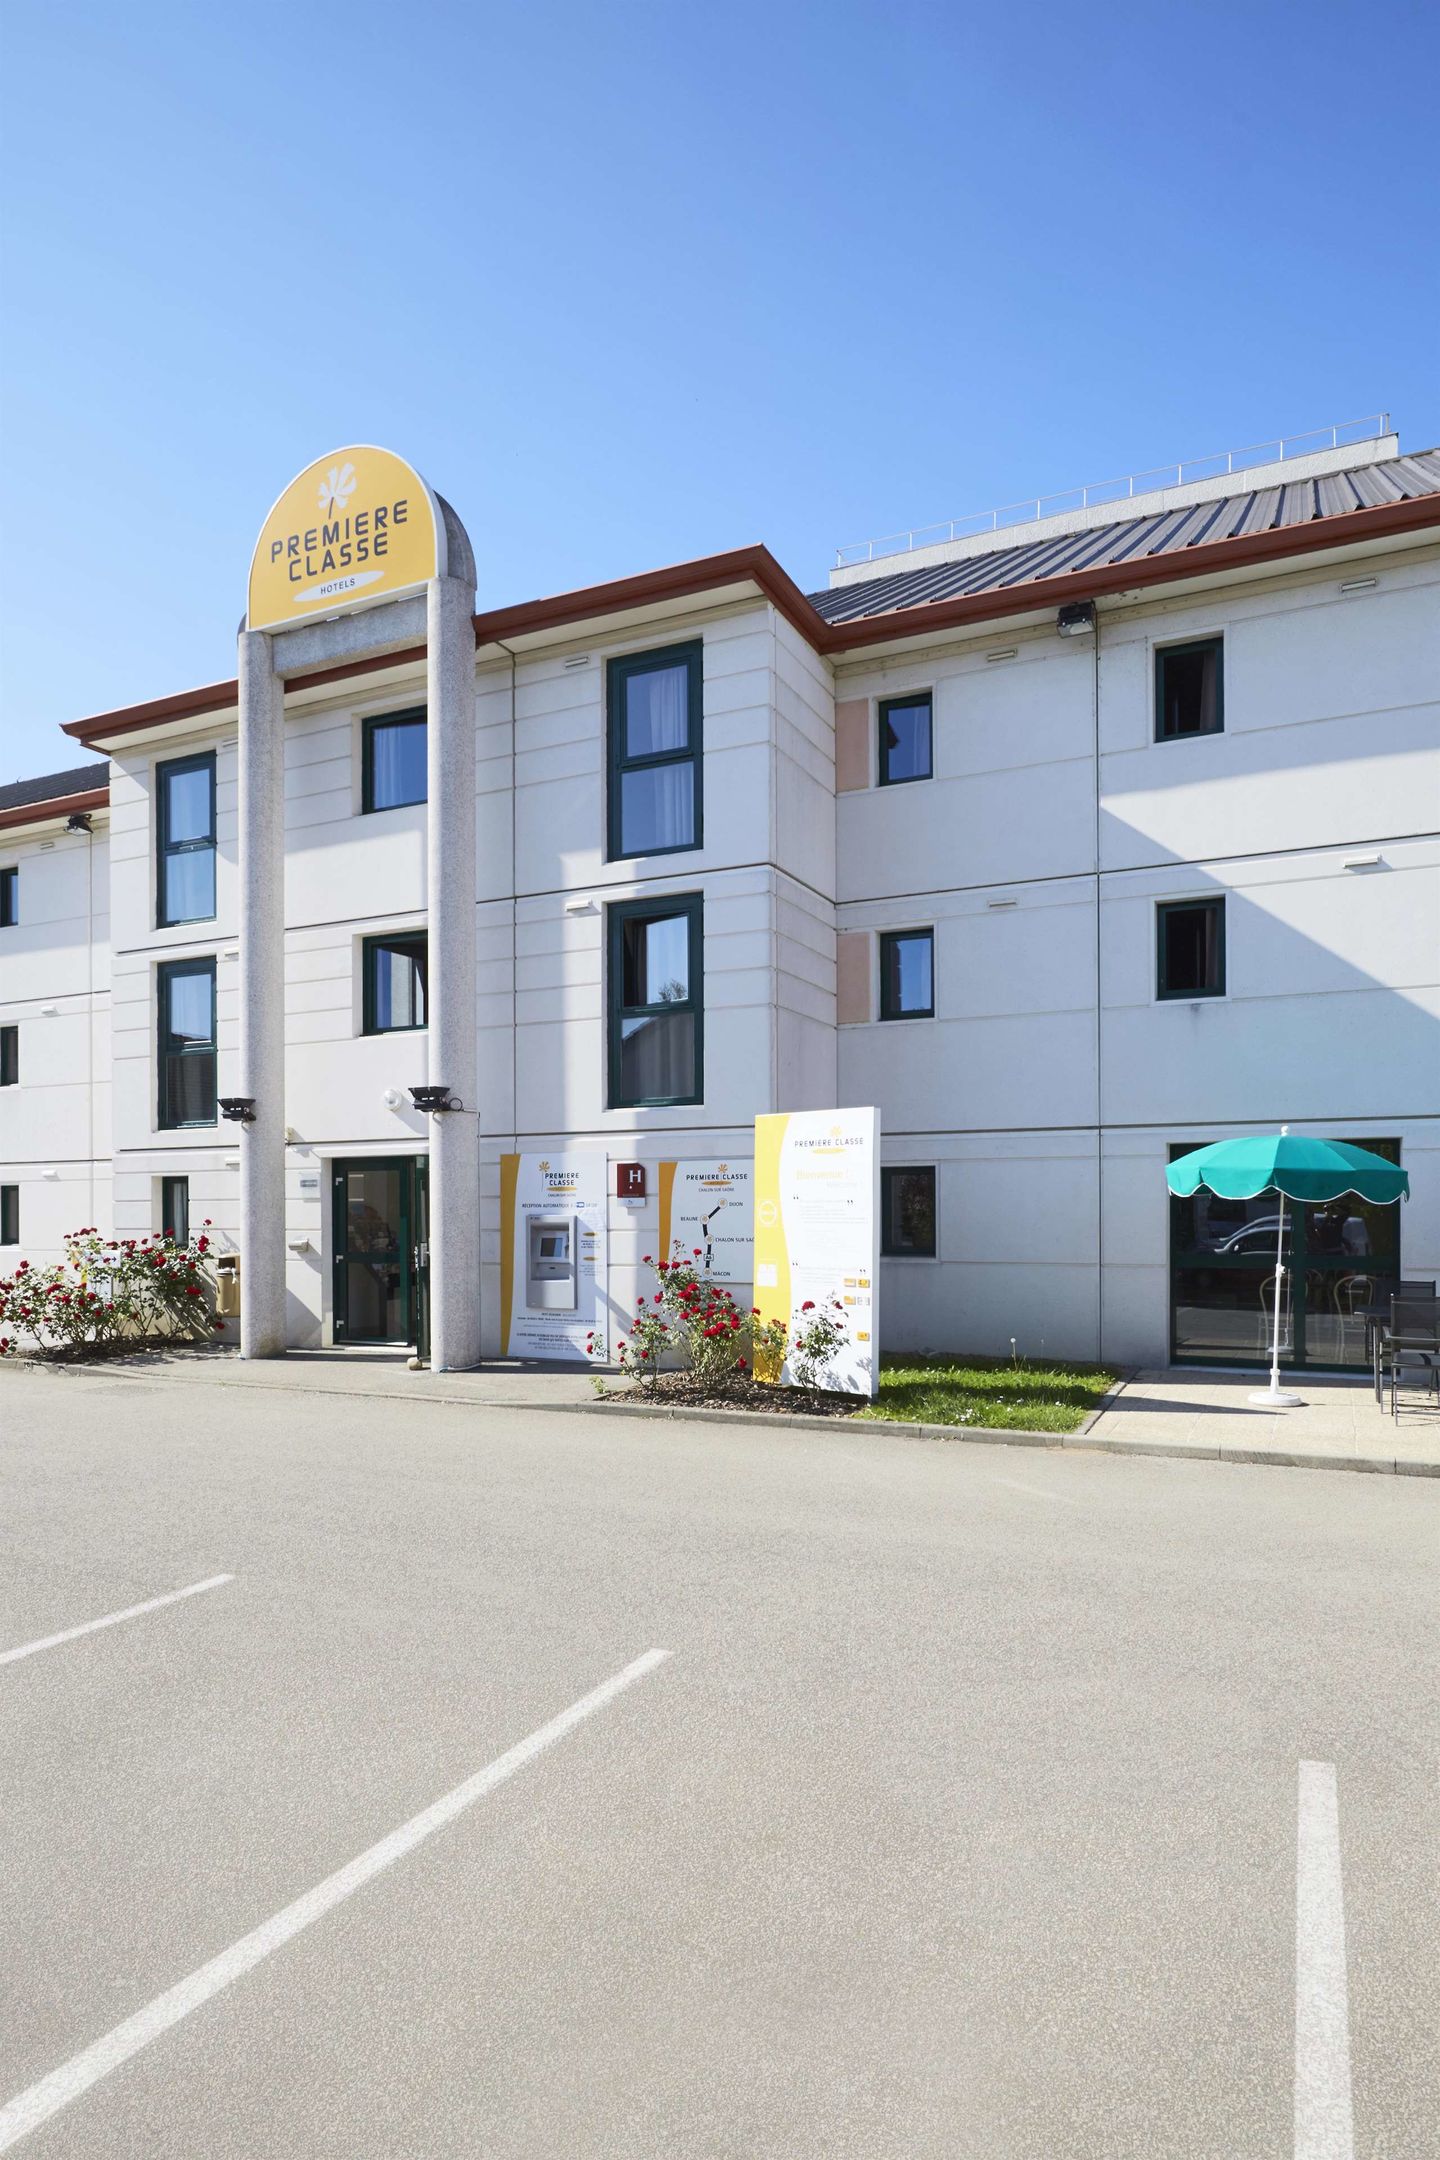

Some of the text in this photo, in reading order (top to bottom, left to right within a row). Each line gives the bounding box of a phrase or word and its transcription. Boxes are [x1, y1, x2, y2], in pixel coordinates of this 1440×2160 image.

[271, 500, 408, 563] PREMIERE
[289, 532, 388, 582] CLASSE
[320, 578, 356, 595] HOTELS
[630, 1170, 641, 1183] H
